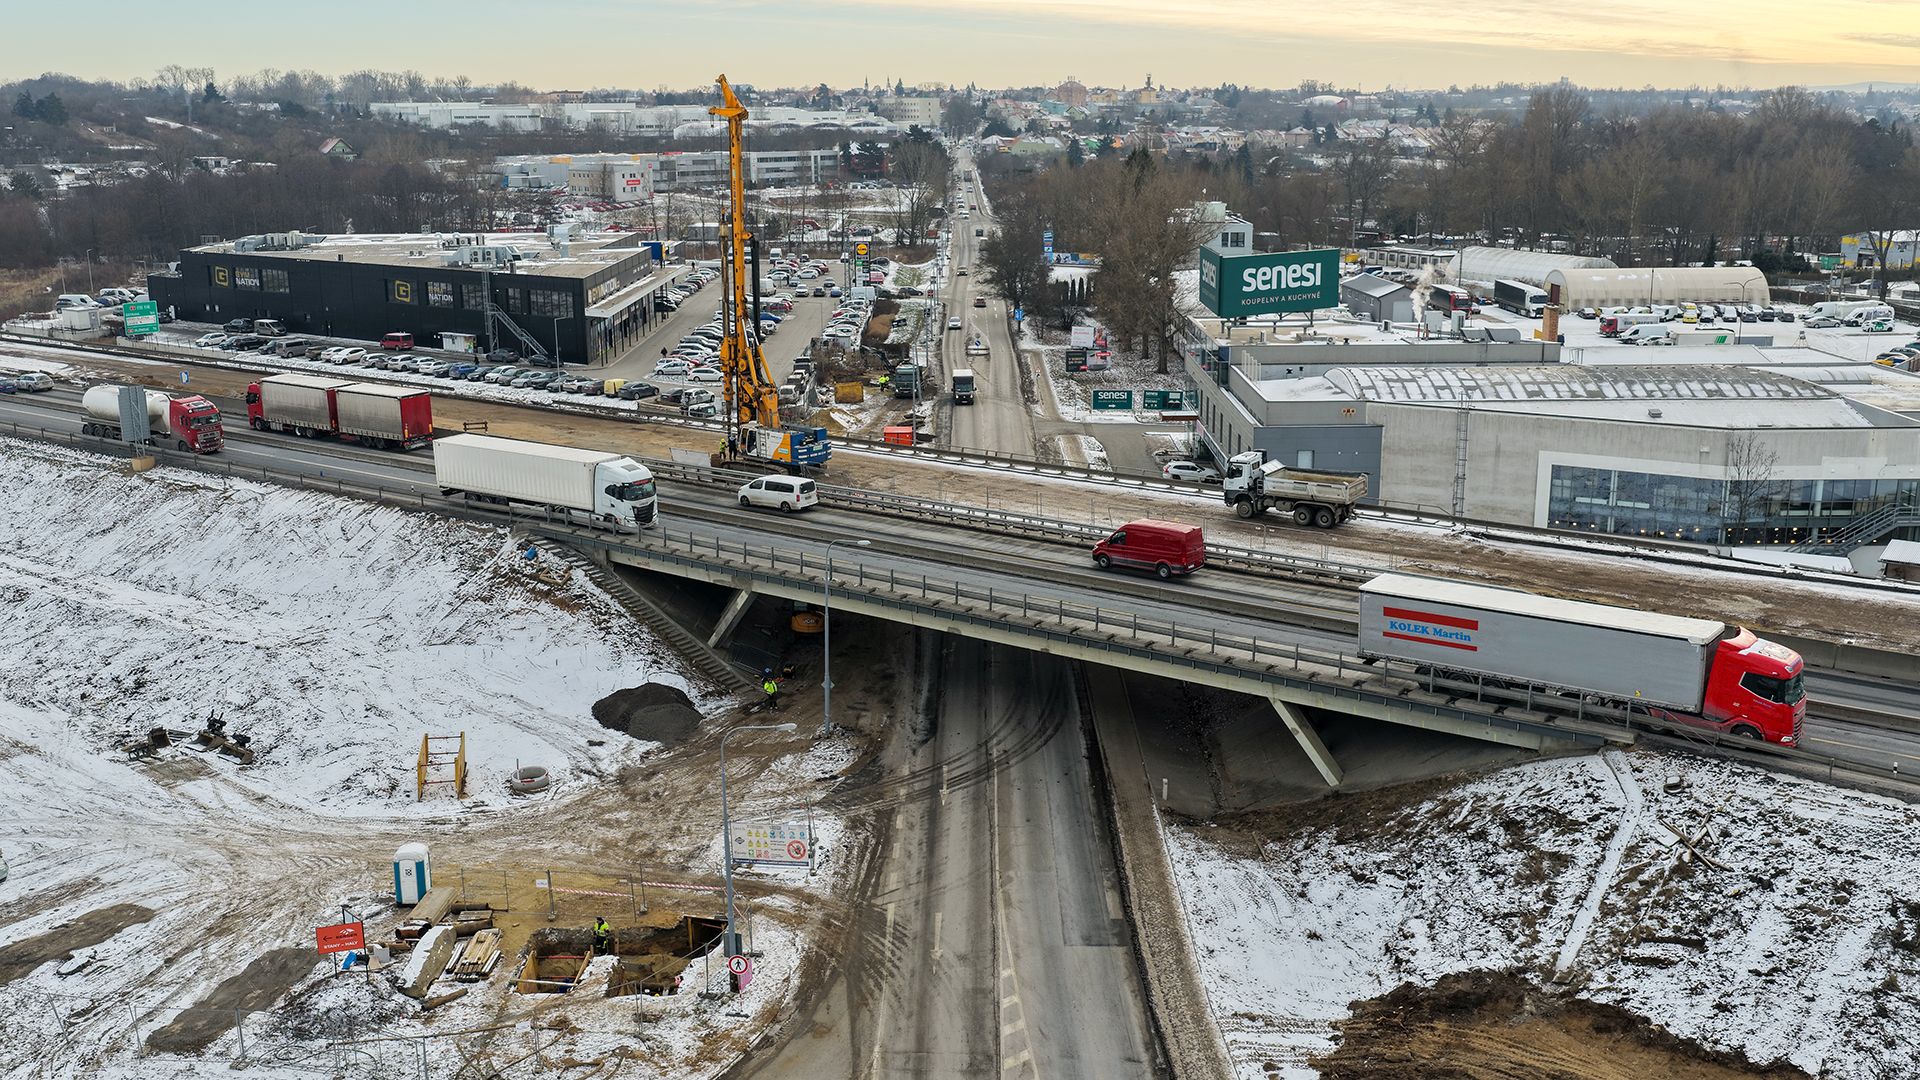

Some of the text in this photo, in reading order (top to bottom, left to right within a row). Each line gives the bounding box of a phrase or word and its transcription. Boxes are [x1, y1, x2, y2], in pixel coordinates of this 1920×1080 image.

[235, 277, 260, 287] NATION
[429, 293, 454, 302] NATION
[1241, 296, 1280, 306] KOUPELNY
[1389, 621, 1472, 642] KOLEK Martin
